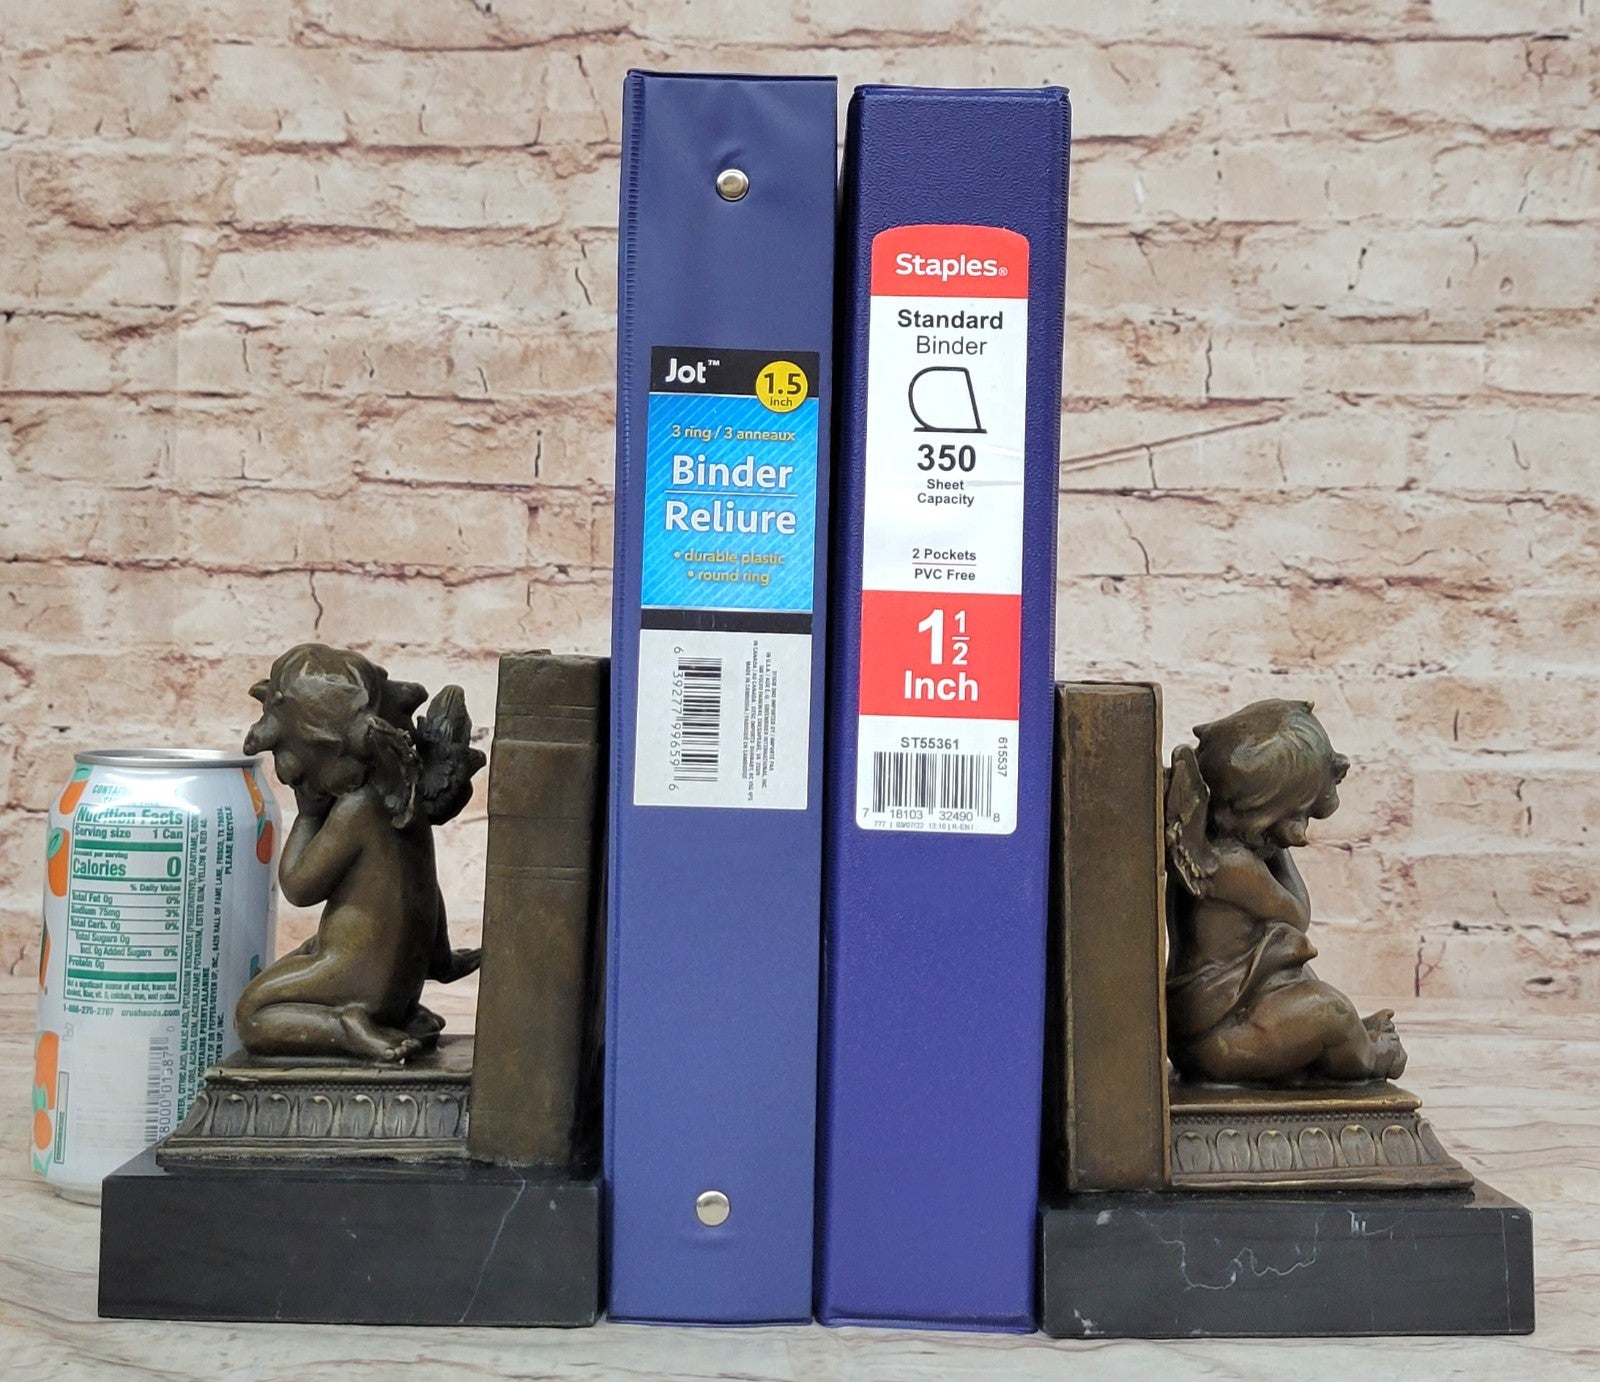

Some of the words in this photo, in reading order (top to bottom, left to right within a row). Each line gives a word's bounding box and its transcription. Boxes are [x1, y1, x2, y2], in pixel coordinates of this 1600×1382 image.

[897, 309, 1004, 329] Standard
[916, 335, 988, 355] Binder
[764, 372, 802, 395] 1.5
[770, 397, 793, 407] inch
[672, 425, 681, 437] 3
[685, 426, 711, 441] ring
[724, 427, 733, 439] 3
[736, 431, 795, 441] anneaux
[917, 443, 976, 472] 350
[672, 454, 794, 489] Binder
[927, 478, 964, 490] Sheet
[917, 492, 974, 507] Capacity
[665, 500, 797, 535] Reliure
[685, 550, 737, 564] durable
[741, 552, 784, 567] plastic
[912, 549, 920, 559] 2
[924, 549, 976, 561] Pockets
[698, 569, 739, 581] round
[743, 570, 770, 586] ring
[914, 568, 943, 580] PVC
[947, 569, 976, 581] Free
[674, 646, 684, 654] 6
[672, 671, 683, 714] 39277
[904, 670, 979, 701] Inch
[670, 723, 681, 766] 99659
[901, 737, 959, 749] ST55361
[997, 737, 1008, 777] 615537
[77, 806, 136, 824] Nutrition
[141, 809, 182, 824] Facts
[225, 806, 233, 841] RECYCLE
[862, 808, 869, 817] 7
[890, 809, 923, 820] 18103
[939, 811, 973, 821] 32490
[993, 813, 1000, 822] 8
[75, 826, 107, 839] Serving
[111, 827, 131, 838] size
[153, 829, 158, 839] 1
[163, 829, 183, 839] Can
[190, 834, 198, 875] ASPARTAME,
[225, 844, 233, 874] PLEASE
[73, 858, 126, 876] Calories
[167, 856, 181, 877] 0
[198, 856, 206, 882] YELLOW
[72, 891, 87, 901] Total
[89, 895, 100, 903] Fat
[104, 895, 113, 904] 0g
[71, 905, 96, 915] Sodium
[99, 908, 120, 918] 75mg
[196, 904, 204, 926] ESTER
[71, 917, 85, 927] Total
[111, 922, 120, 931] 0g
[165, 923, 179, 931] 0%
[92, 933, 117, 943] Sugars
[120, 935, 130, 944] 0g
[104, 947, 125, 956] Added
[127, 948, 151, 957] Sugars
[164, 948, 177, 957] 0%
[69, 956, 92, 966] Protein
[200, 968, 209, 1034] PHENYLALANINE
